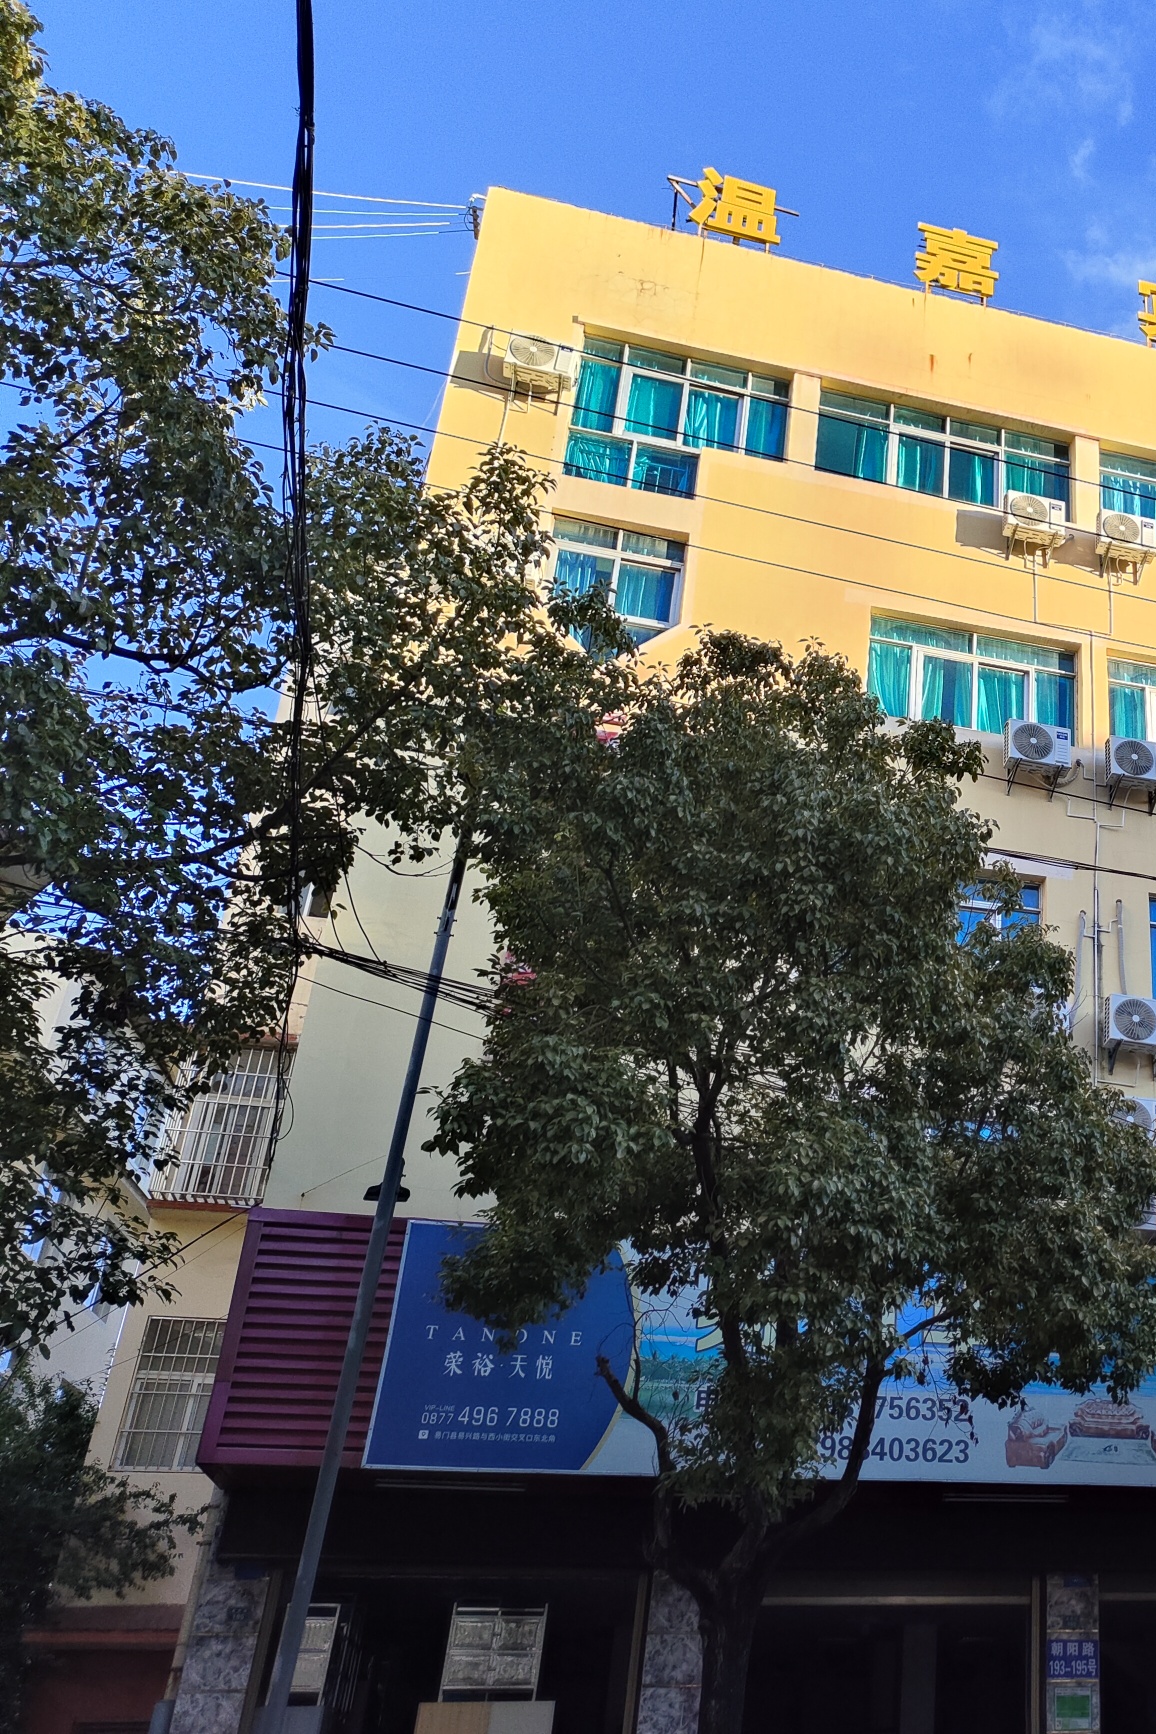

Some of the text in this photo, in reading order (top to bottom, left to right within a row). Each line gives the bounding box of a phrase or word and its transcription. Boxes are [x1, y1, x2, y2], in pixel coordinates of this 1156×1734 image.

[420, 1405, 560, 1428] 0877 496 7888
[1051, 1642, 1094, 1656] 朝阳路
[1049, 1659, 1096, 1676] 193-195号
